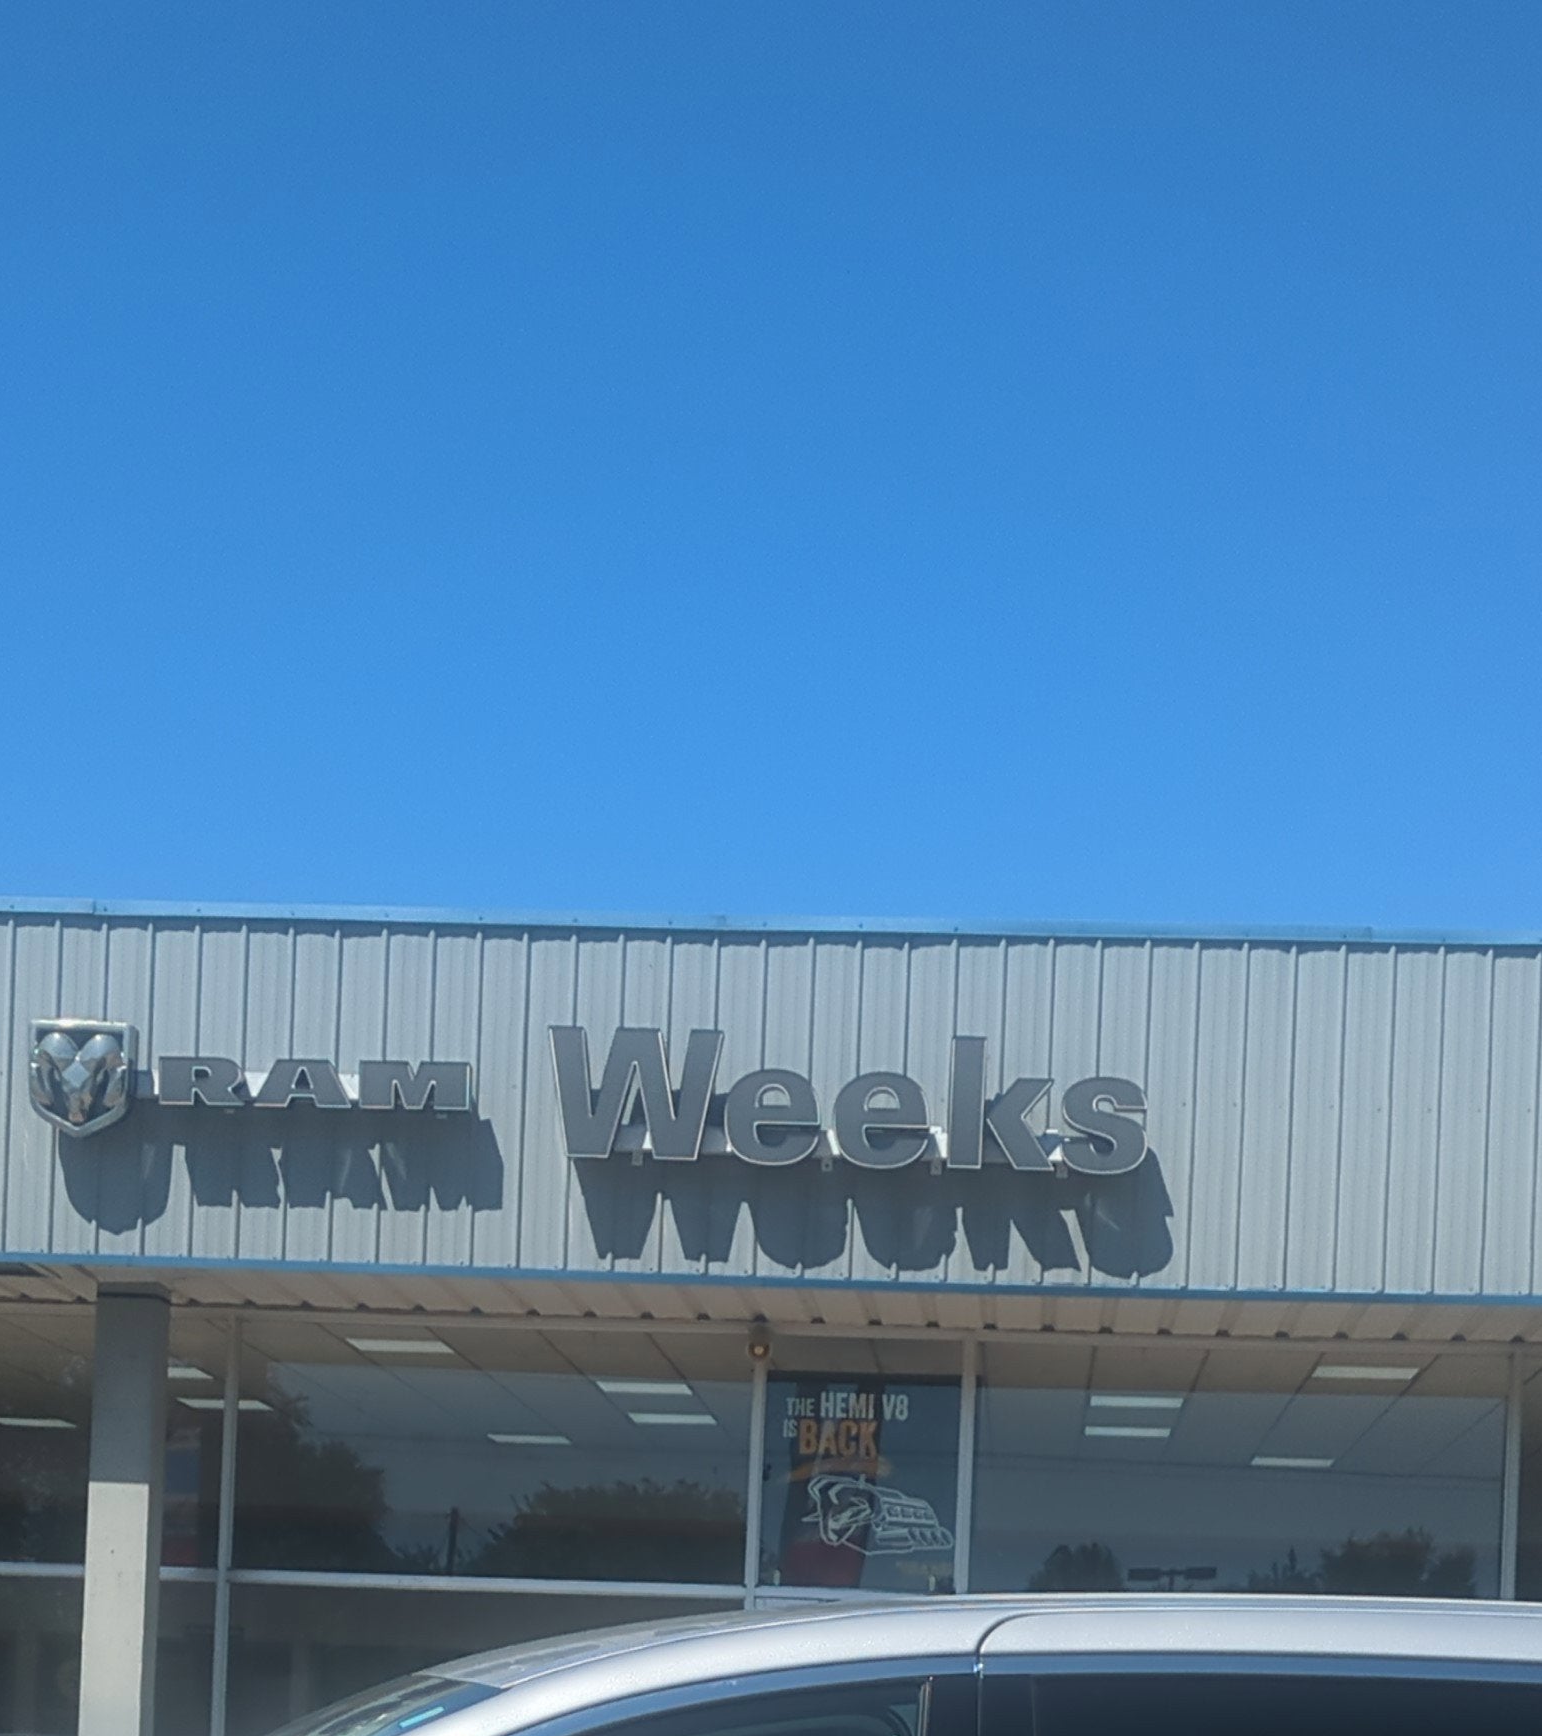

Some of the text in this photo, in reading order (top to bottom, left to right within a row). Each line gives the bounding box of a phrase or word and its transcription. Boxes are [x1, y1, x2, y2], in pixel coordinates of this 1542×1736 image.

[158, 1056, 472, 1112] RAM
[548, 1025, 1148, 1174] Weeks
[786, 1391, 909, 1421] THE HEMI V8
[782, 1418, 878, 1459] IS BACK
